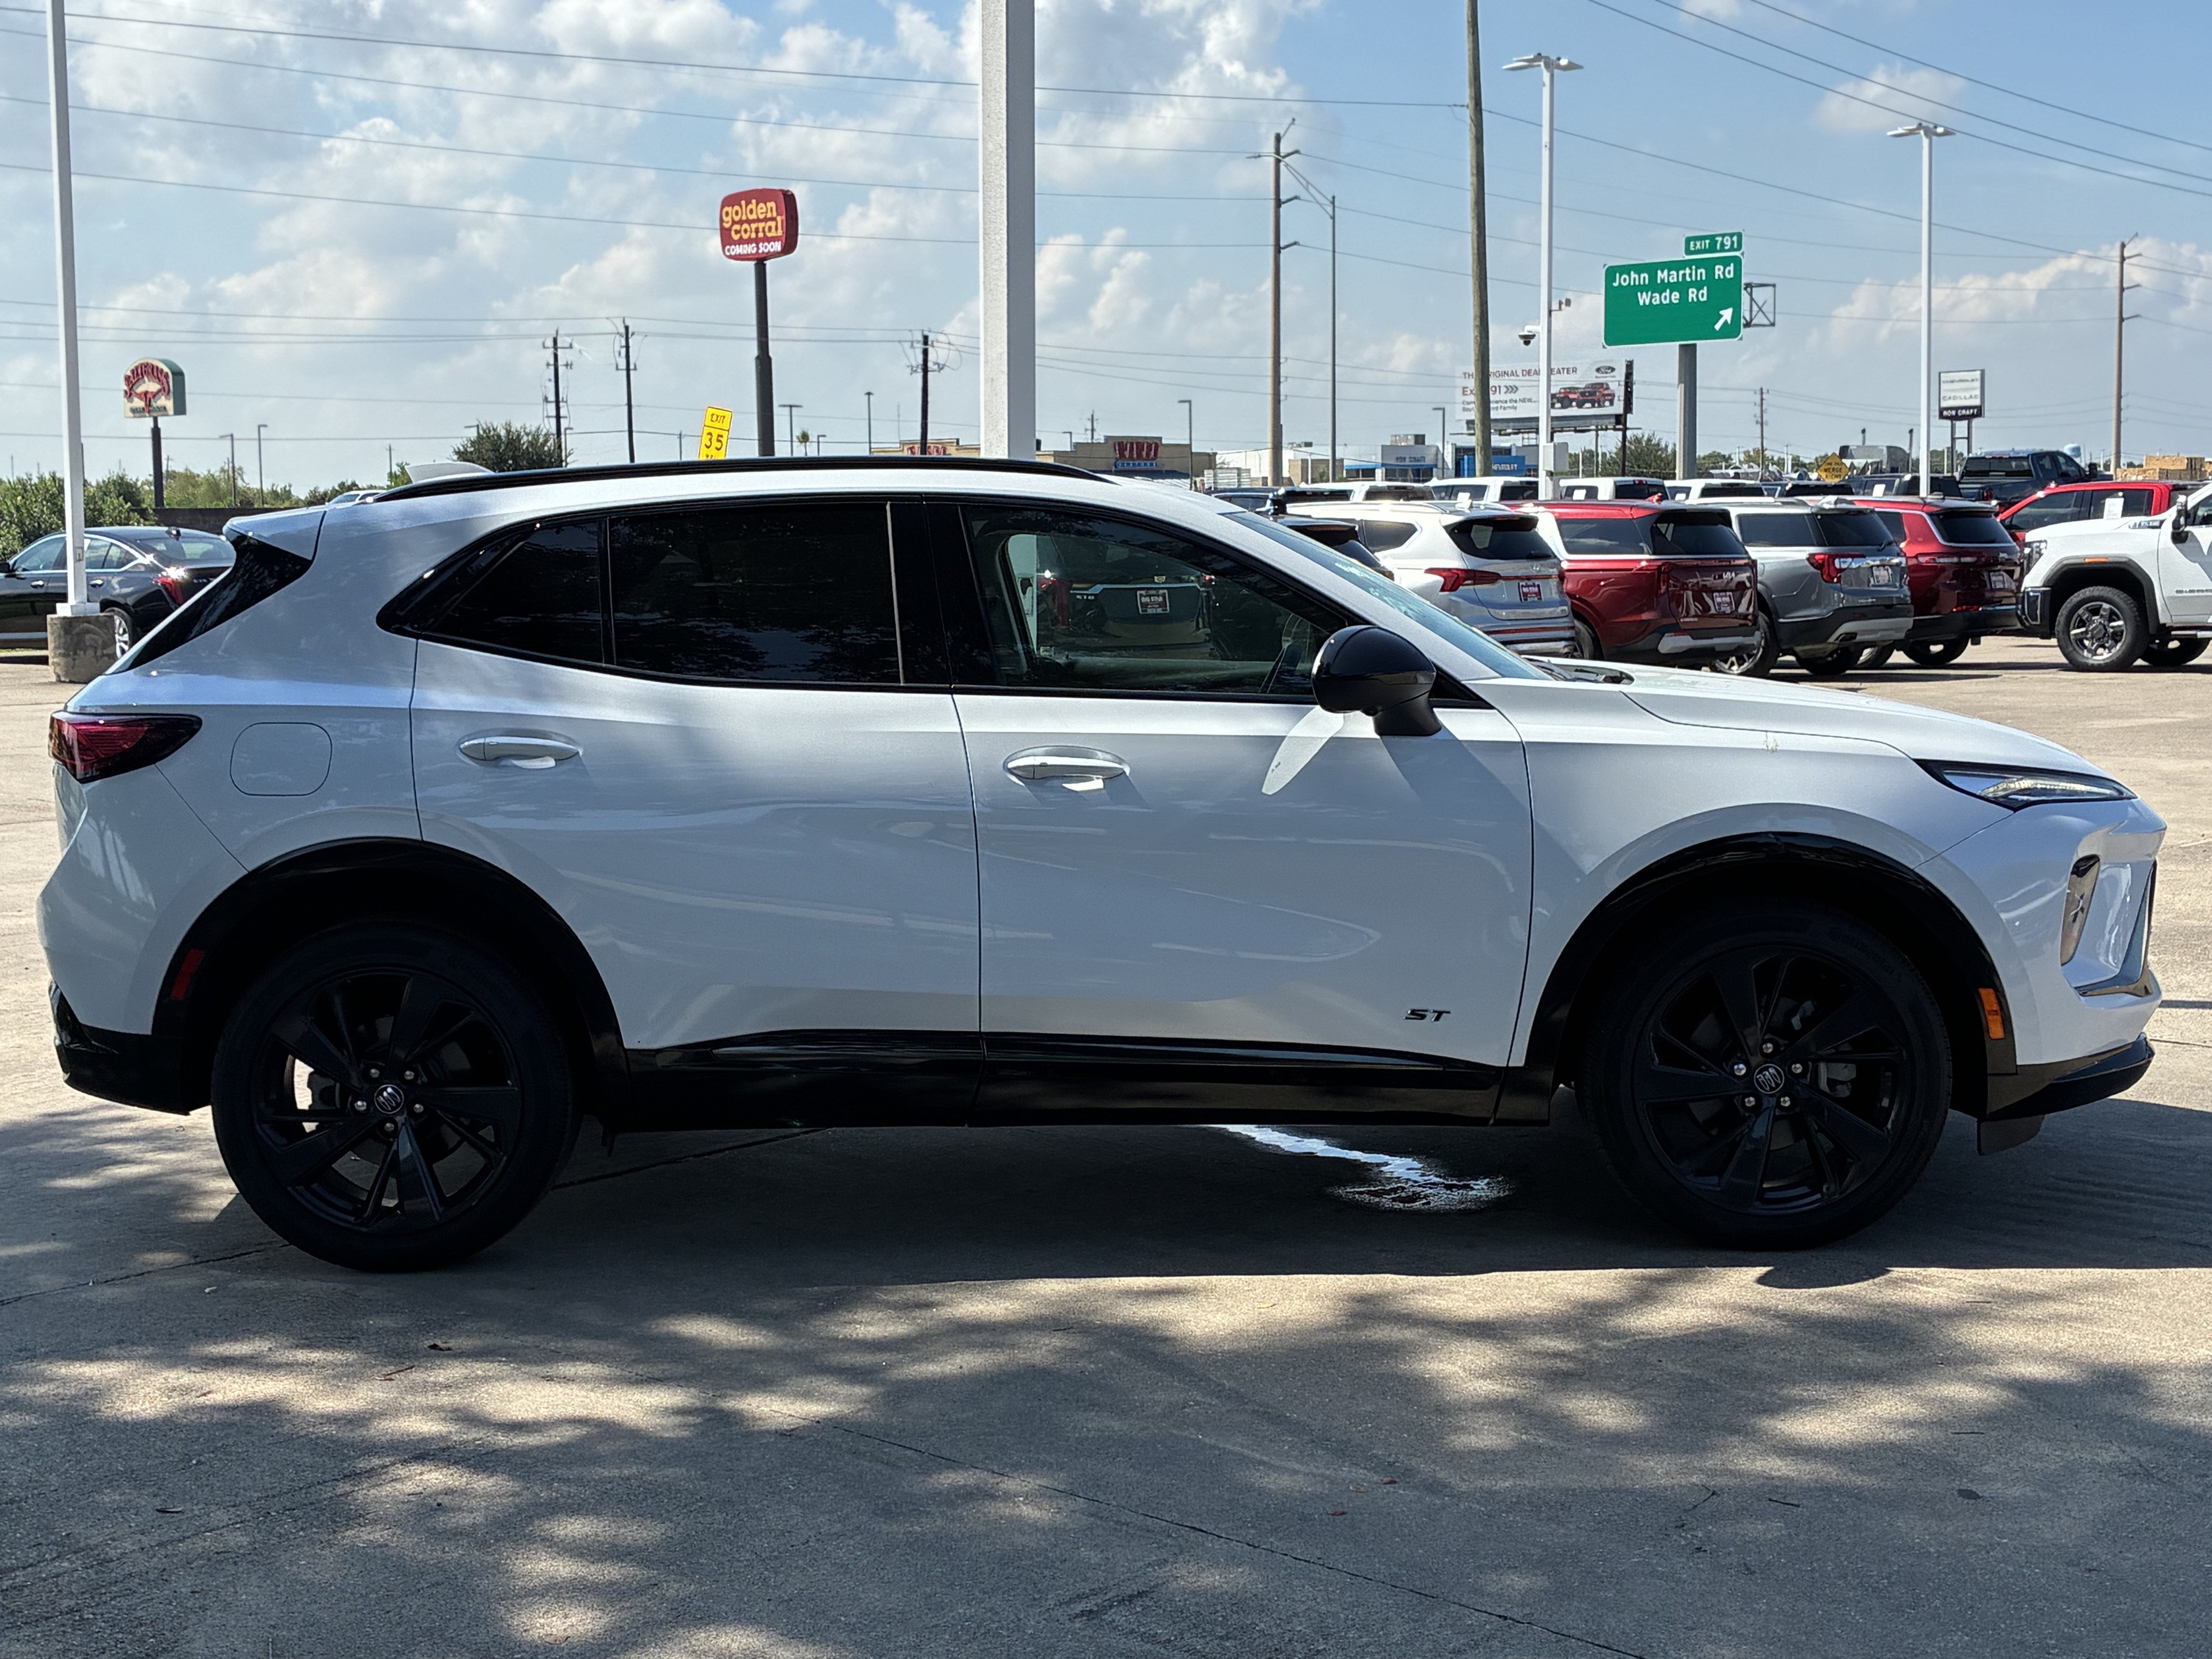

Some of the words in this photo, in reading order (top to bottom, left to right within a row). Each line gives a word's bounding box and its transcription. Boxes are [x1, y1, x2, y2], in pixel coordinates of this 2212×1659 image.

[722, 199, 776, 228] golden
[731, 216, 783, 240] corral
[725, 243, 757, 256] COMING
[759, 241, 781, 253] SOON
[1690, 239, 1710, 251] EXIT
[1715, 235, 1737, 250] 791
[1612, 271, 1649, 287] John
[1657, 265, 1706, 283] Martin
[1715, 263, 1734, 279] Rd
[1637, 288, 1680, 306] Wade
[1688, 286, 1707, 302] Rd
[1489, 369, 1520, 378] RIGINAL
[1551, 367, 1578, 375] EATER
[1462, 386, 1475, 396] Ex
[1490, 385, 1501, 395] 91
[710, 413, 725, 424] EXIT
[705, 431, 724, 451] 35
[1403, 1008, 1451, 1022] ST
